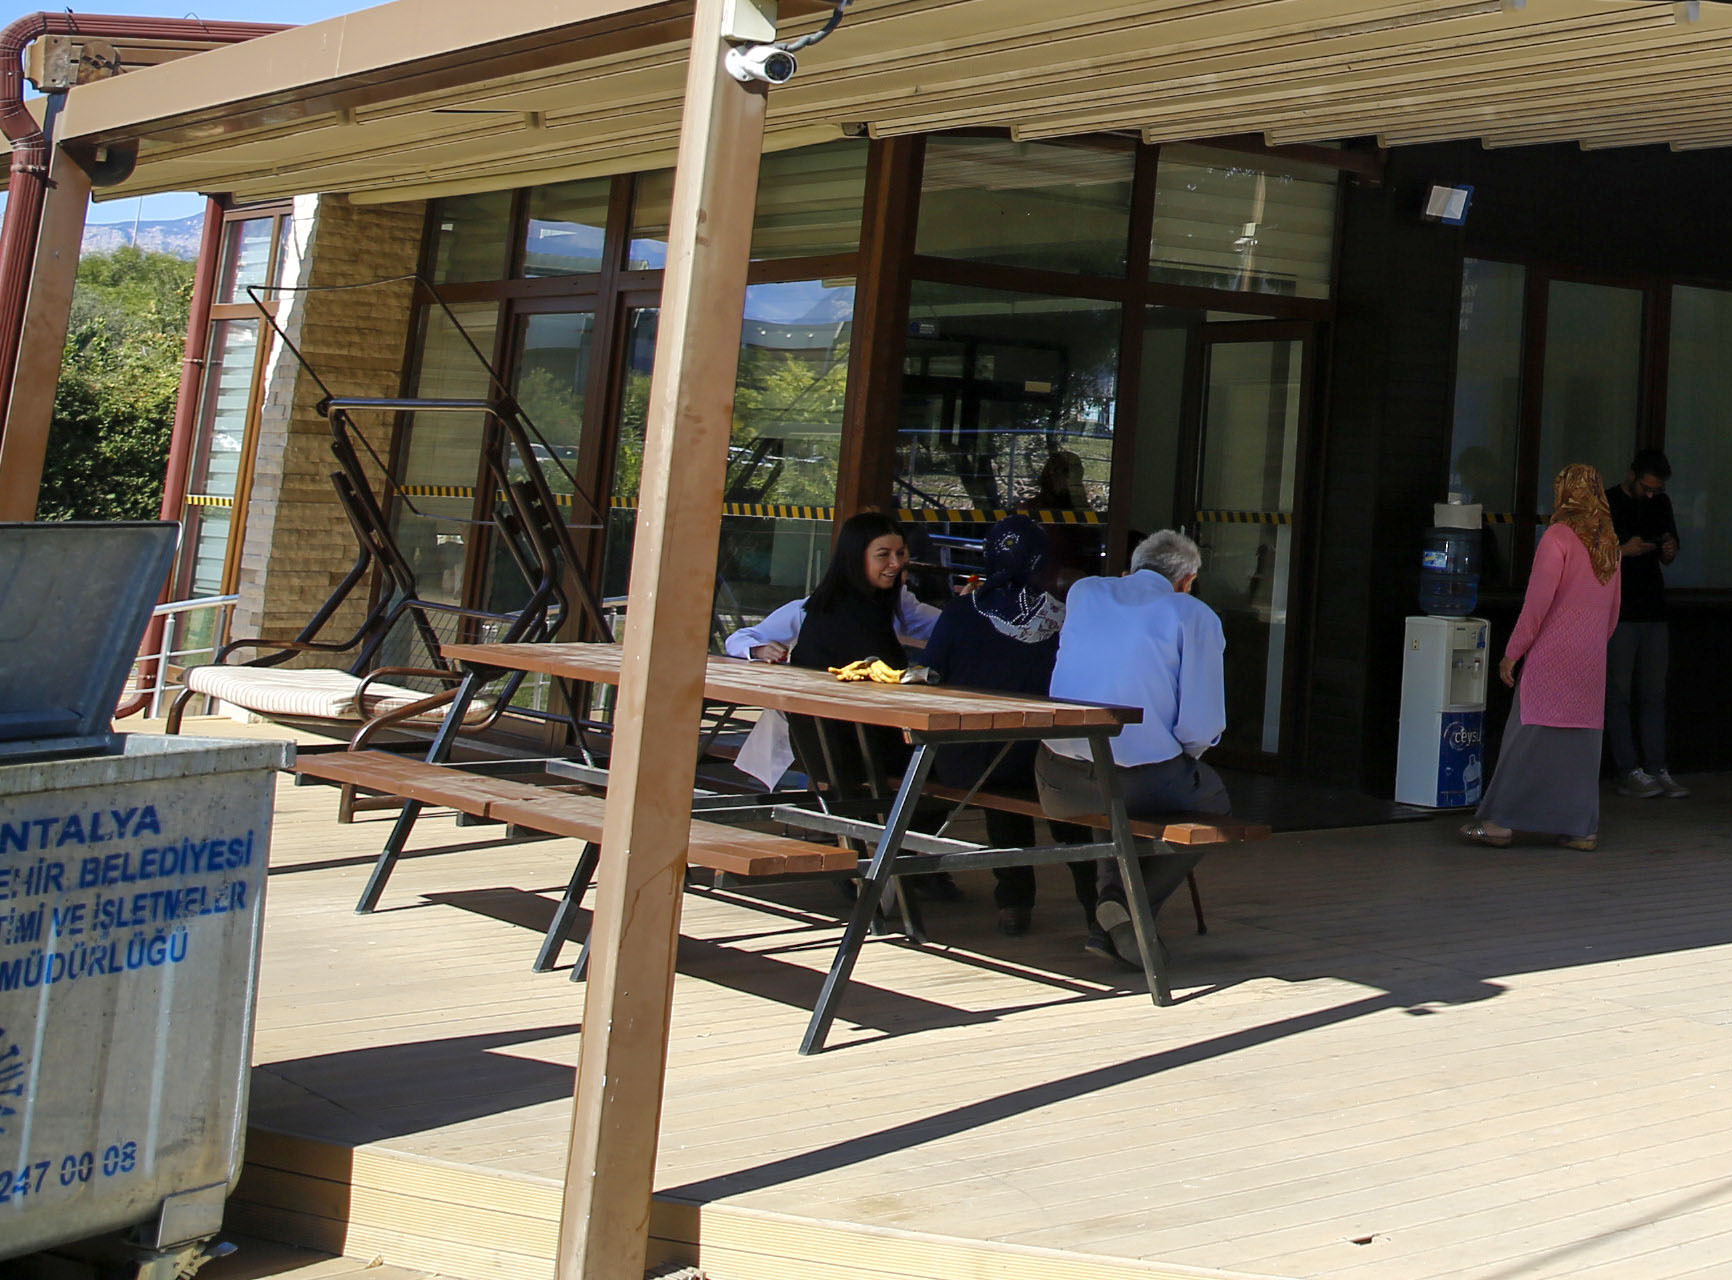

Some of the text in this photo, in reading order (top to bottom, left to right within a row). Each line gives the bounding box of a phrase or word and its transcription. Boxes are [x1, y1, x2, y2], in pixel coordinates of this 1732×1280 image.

[0, 805, 161, 854] NTALYA
[79, 829, 254, 889] BELEDİYESİ
[53, 903, 86, 937] VE
[91, 880, 247, 940] İŞLETMELER
[0, 926, 189, 992] MÜDÜRLÜĞÜ
[0, 1141, 137, 1203] 247 00 08
